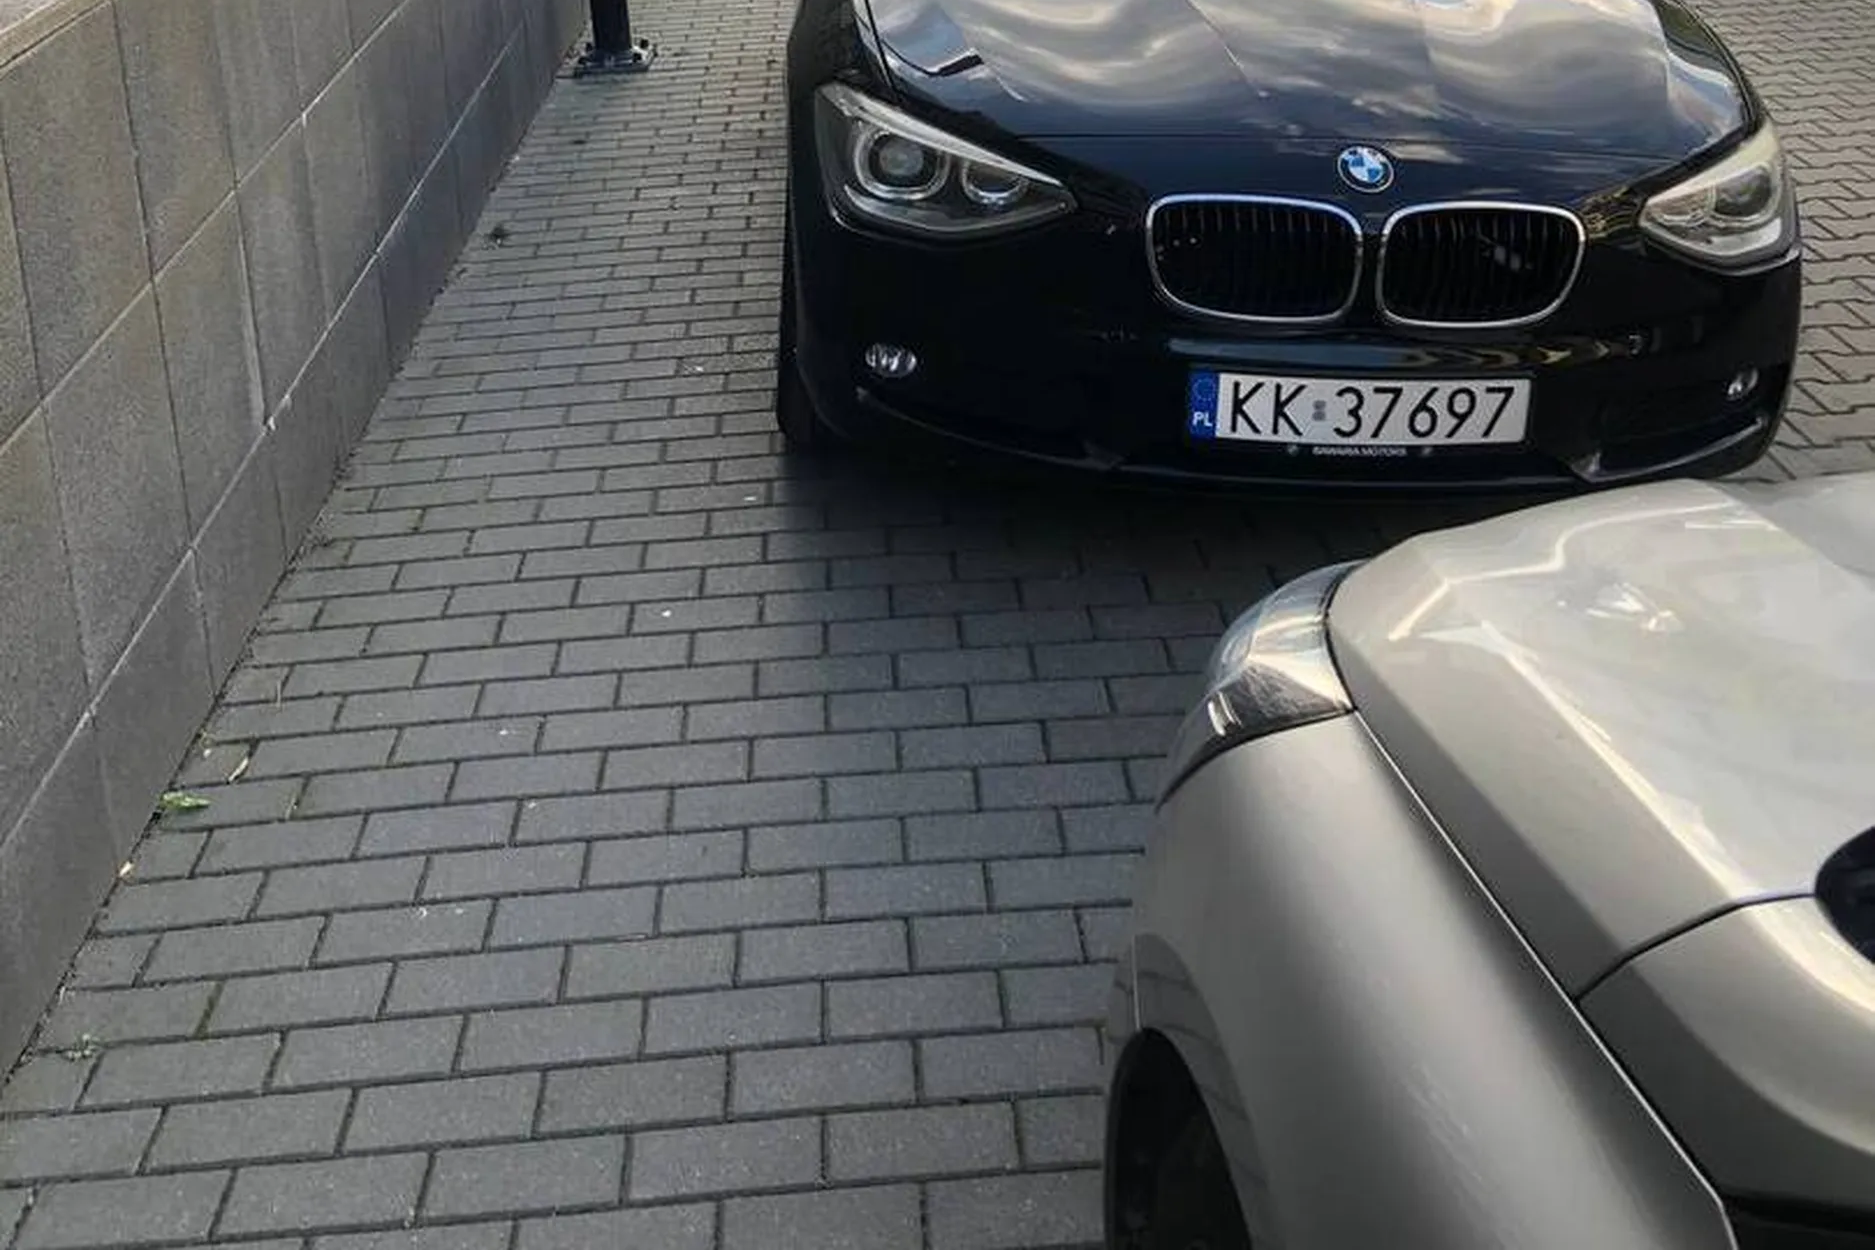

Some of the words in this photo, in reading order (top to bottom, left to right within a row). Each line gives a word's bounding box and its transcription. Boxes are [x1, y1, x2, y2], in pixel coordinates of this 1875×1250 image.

[1193, 411, 1213, 427] PL
[1231, 380, 1308, 437] KK
[1333, 386, 1515, 438] 37697
